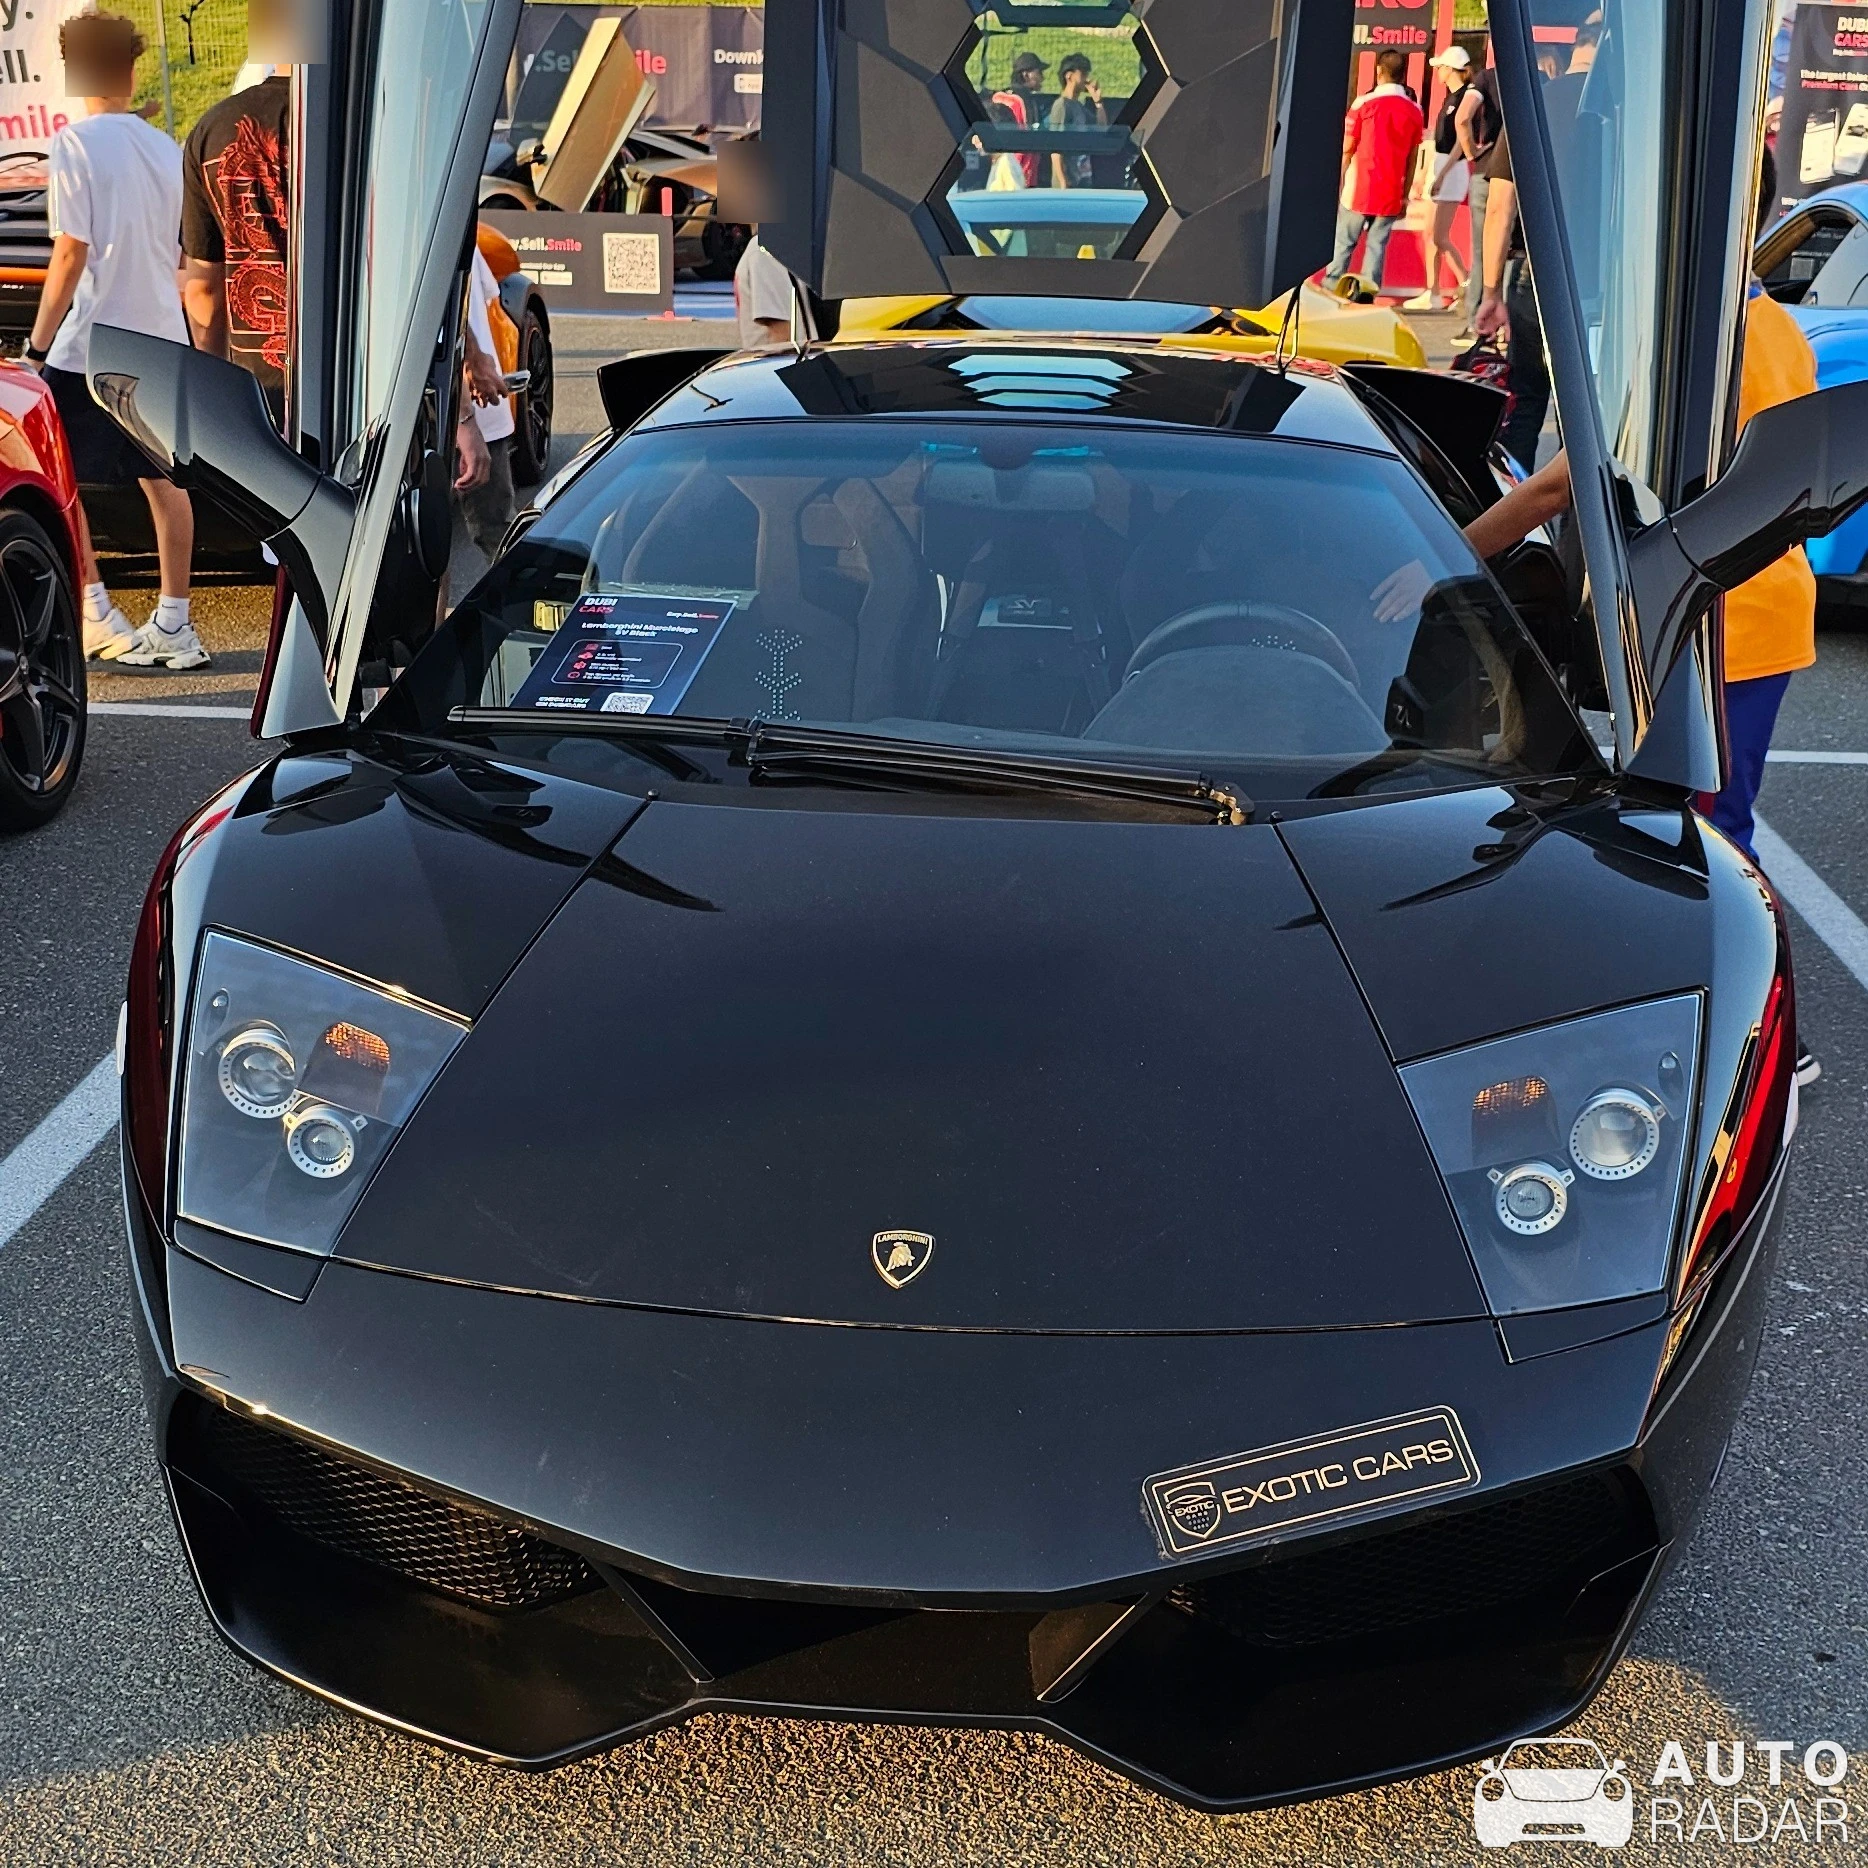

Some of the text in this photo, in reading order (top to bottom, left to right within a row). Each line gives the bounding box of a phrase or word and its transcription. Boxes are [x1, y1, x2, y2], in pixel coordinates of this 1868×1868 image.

[0, 50, 41, 83] ll.
[582, 622, 643, 632] Lamborghini
[878, 1234, 928, 1245] LAMBORGHINI
[1221, 1439, 1455, 1513] EXOTIC CARS
[1174, 1500, 1215, 1518] EXOTIC
